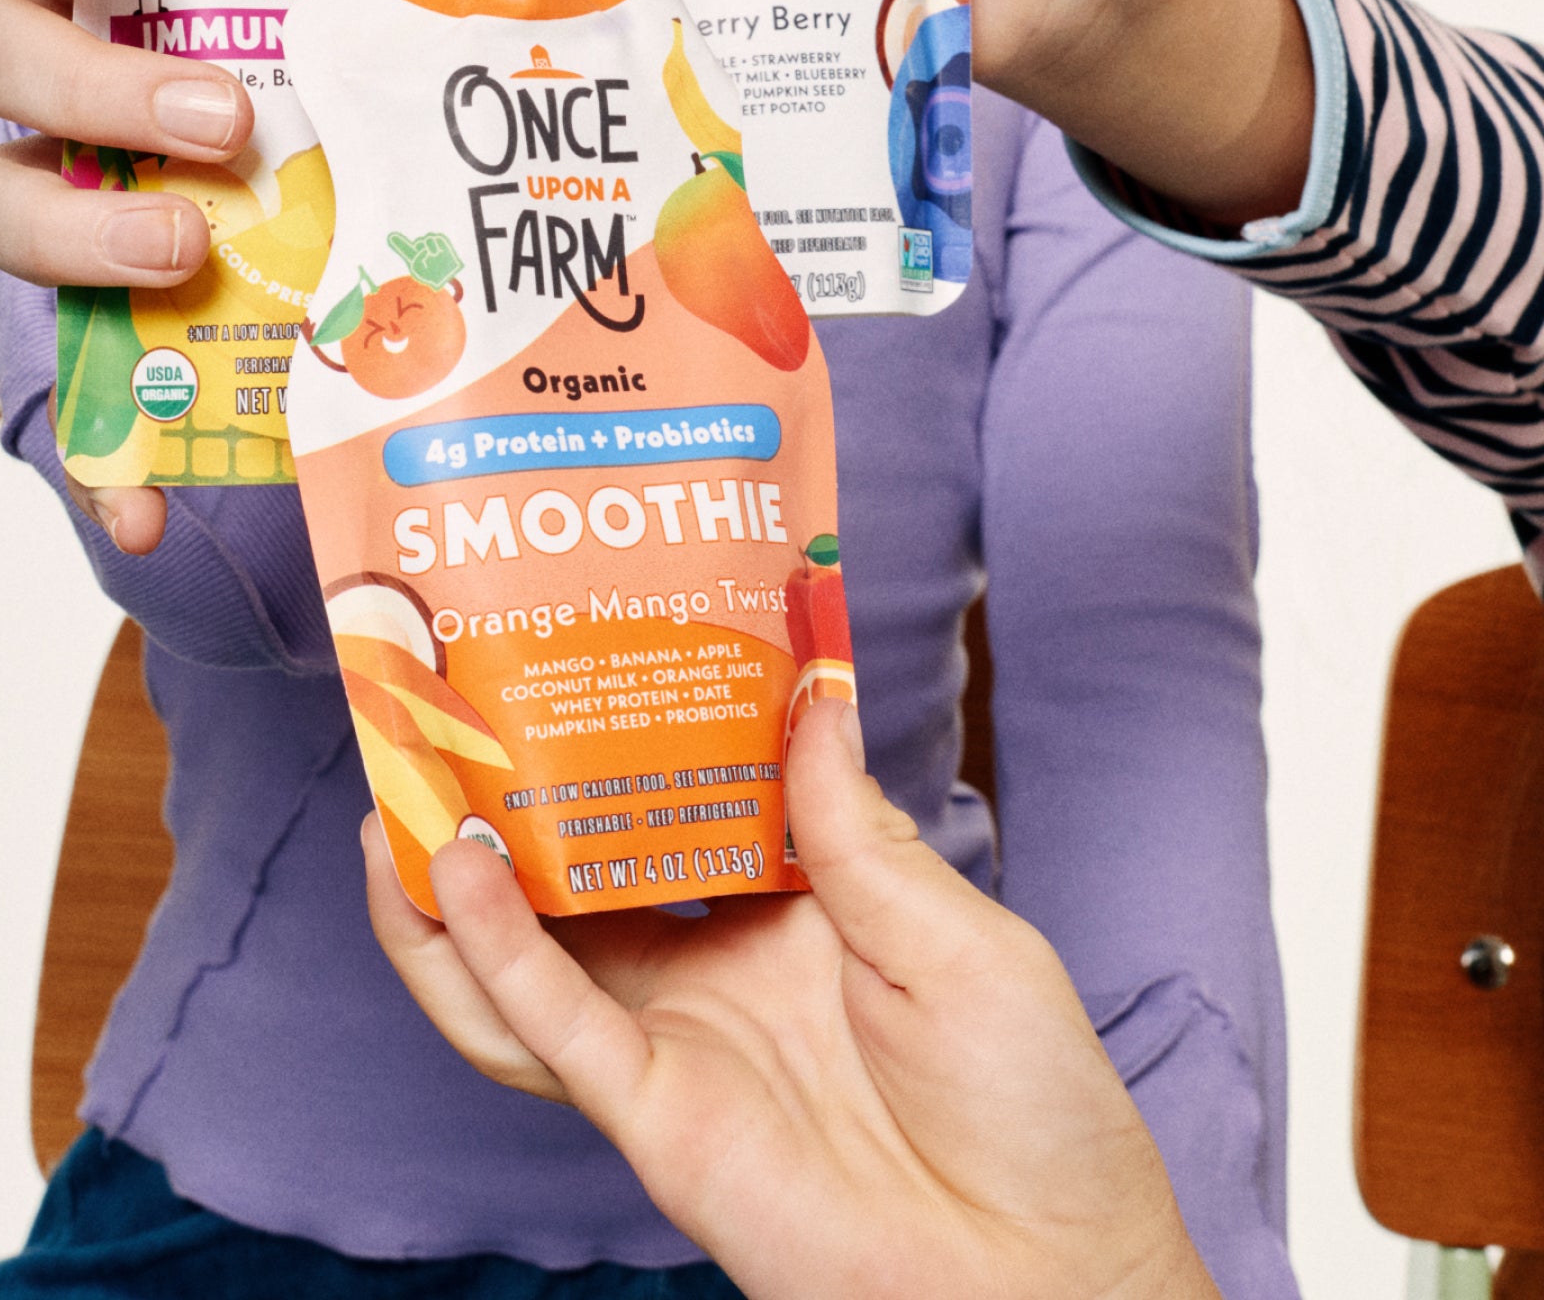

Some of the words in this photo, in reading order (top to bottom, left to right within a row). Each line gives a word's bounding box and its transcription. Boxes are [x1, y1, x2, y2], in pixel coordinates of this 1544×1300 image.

[142, 16, 285, 54] IMMUN
[697, 15, 759, 39] erry
[772, 6, 851, 37] Berry
[746, 71, 781, 83] MILK
[795, 68, 867, 81] BLUEBERRY
[752, 52, 841, 67] STRAWBERRY
[744, 86, 809, 100] PUMPKIN
[813, 84, 846, 97] SEED
[770, 101, 826, 115] POTATO
[443, 64, 639, 176] ONCE
[526, 175, 603, 202] UPON
[612, 181, 631, 202] A
[467, 182, 645, 333] FARM
[807, 270, 866, 302] (113g)
[221, 326, 230, 341] A
[233, 324, 260, 341] LOW
[146, 366, 183, 381] USDA
[523, 365, 647, 401] Organic
[141, 388, 189, 401] ORGANIC
[236, 387, 270, 415] NET
[425, 439, 467, 469] 4g
[474, 425, 585, 459] Protein
[591, 431, 608, 448] +
[614, 417, 755, 451] Probiotics
[393, 478, 788, 576] SMOOTHIE
[431, 601, 576, 644] Orange
[588, 585, 711, 625] Mango
[717, 577, 788, 613] Twist
[524, 656, 595, 678] MANGO
[610, 649, 682, 668] BANANA
[697, 643, 742, 660] APPLE
[501, 677, 592, 702] COCONUT
[597, 673, 637, 690] MILK
[653, 666, 722, 685] ORANGE
[725, 662, 764, 679] JUICE
[550, 697, 603, 716] WHEY
[608, 690, 678, 710] PROTEIN
[694, 685, 732, 701] DATE
[525, 717, 606, 741] PUMPKIN
[610, 713, 651, 730] SEED
[667, 703, 758, 724] PROBIOTICS
[540, 789, 548, 805] A
[552, 784, 579, 803] LOW
[583, 777, 632, 799] CALORIE
[674, 769, 694, 788] SEE
[697, 764, 757, 786] NUTRITION
[558, 813, 633, 839] PERISHABLE
[647, 808, 674, 828] KEEP
[679, 799, 760, 823] REFRIGERATED
[568, 862, 603, 894] NET
[609, 858, 638, 888] WT
[645, 854, 658, 884] 4
[663, 852, 687, 882] OZ
[694, 842, 764, 882] (113g)
